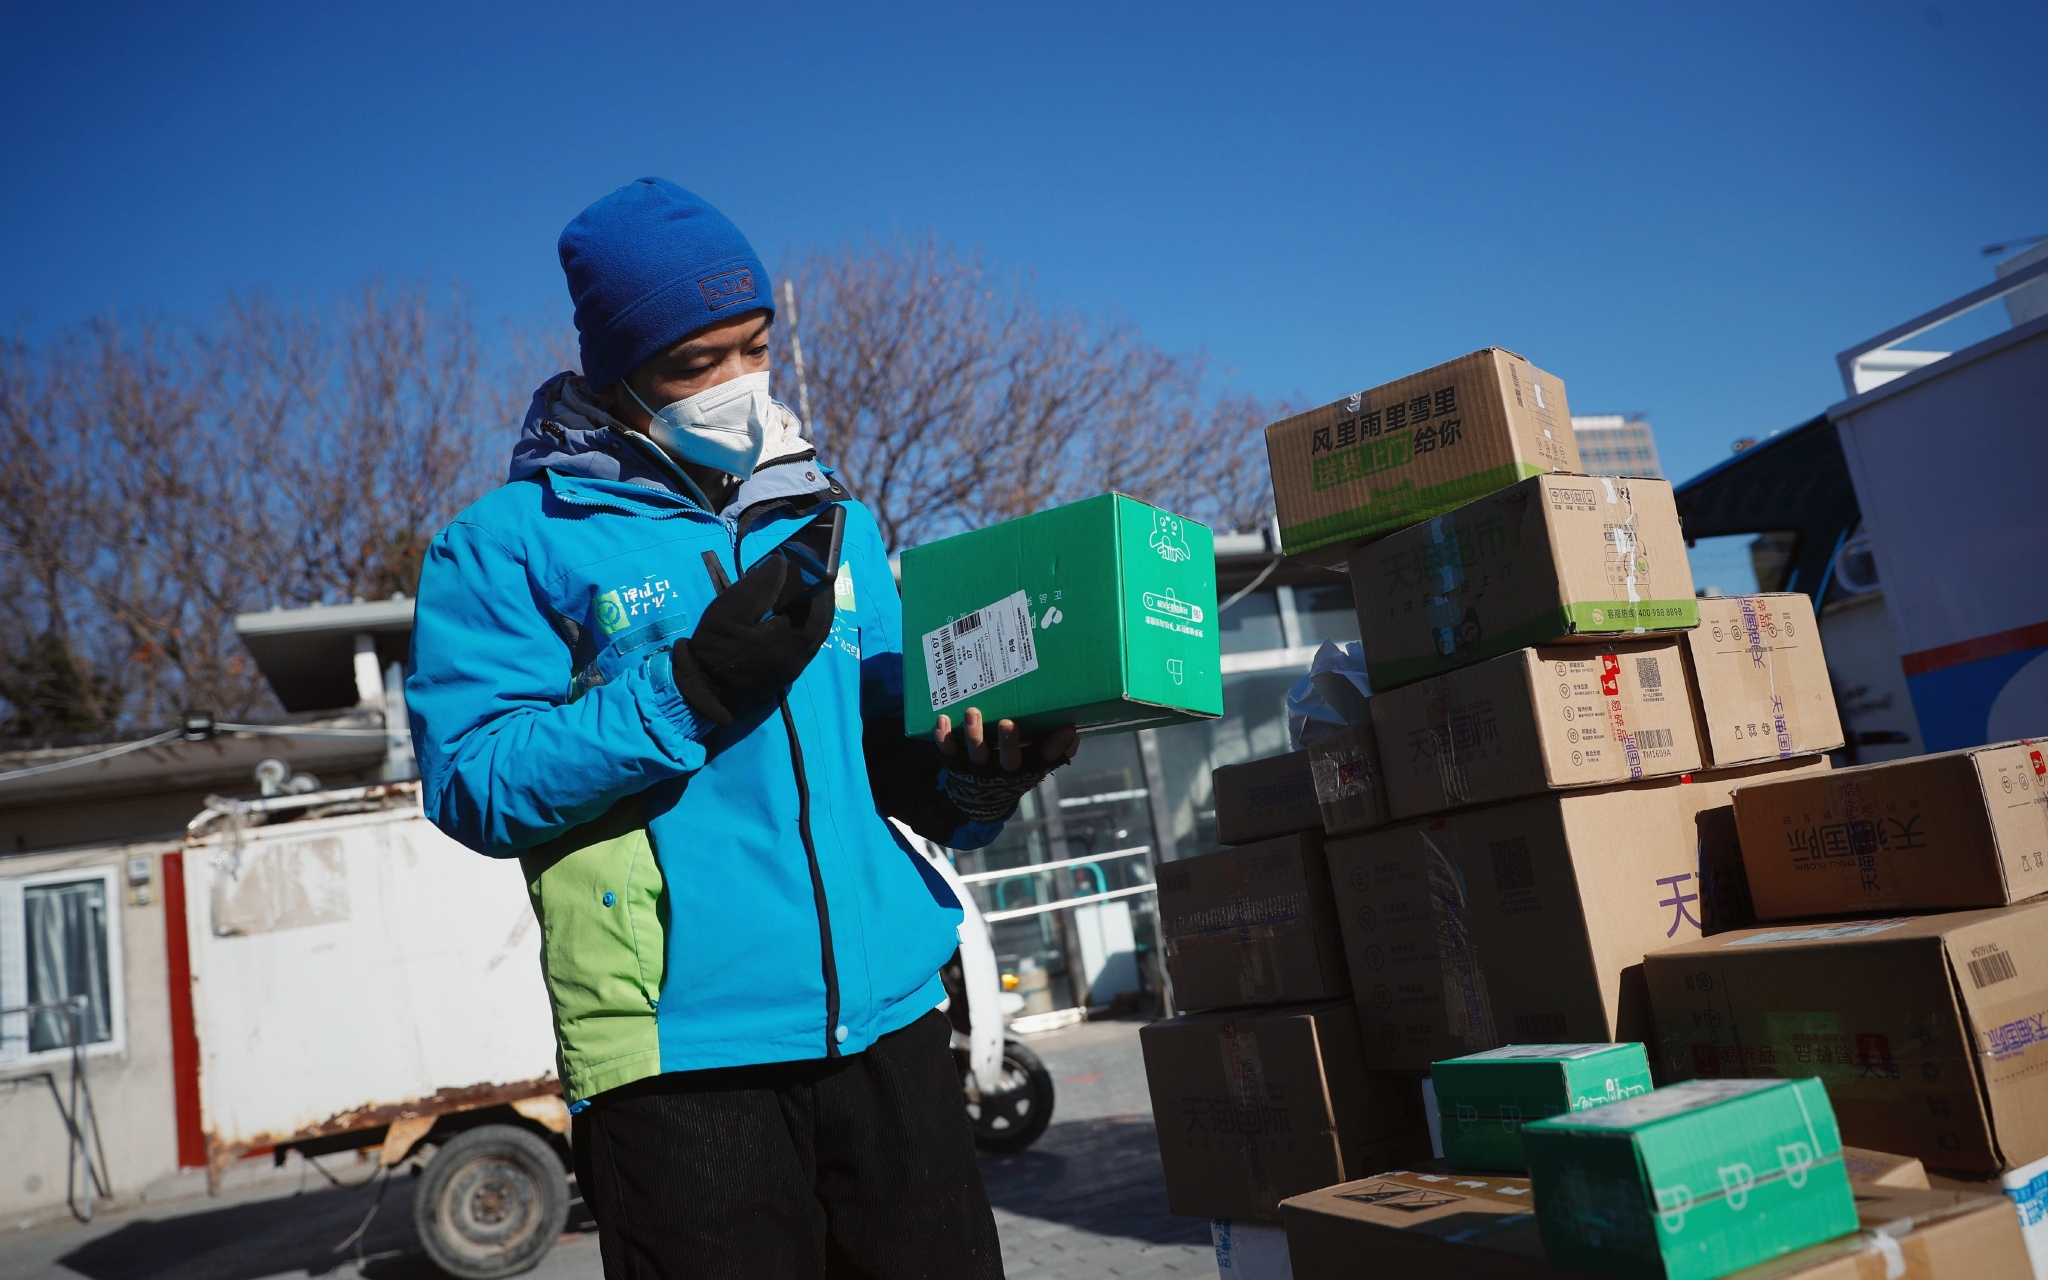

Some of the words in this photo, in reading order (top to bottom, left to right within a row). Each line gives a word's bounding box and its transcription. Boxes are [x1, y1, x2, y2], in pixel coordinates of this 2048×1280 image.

[1311, 385, 1457, 456] 风里雨里雪里
[1315, 435, 1411, 487] 送货上门
[1414, 418, 1462, 455] 给你
[1382, 515, 1506, 596] 天猫超市
[1607, 609, 1635, 619] 客服热线
[1638, 608, 1651, 618] 400
[932, 637, 939, 649] 07
[935, 651, 944, 676] B614
[966, 650, 973, 659] 07
[1468, 698, 1493, 711] GLOBAL
[1407, 708, 1499, 762] 天猫国际
[1643, 751, 1671, 759] TM1609A
[1245, 776, 1312, 811] 天猫国际
[1250, 851, 1294, 875] 天猫国际
[1793, 861, 1827, 872] GLOBAL
[1831, 858, 1857, 868] TMALL
[1382, 902, 1409, 915] 全球品质
[1389, 943, 1416, 954] 海外价格
[1721, 1045, 1776, 1065] 易碎品
[1795, 1044, 1854, 1065] 易碎品
[1181, 1095, 1292, 1135] 天猫国际
